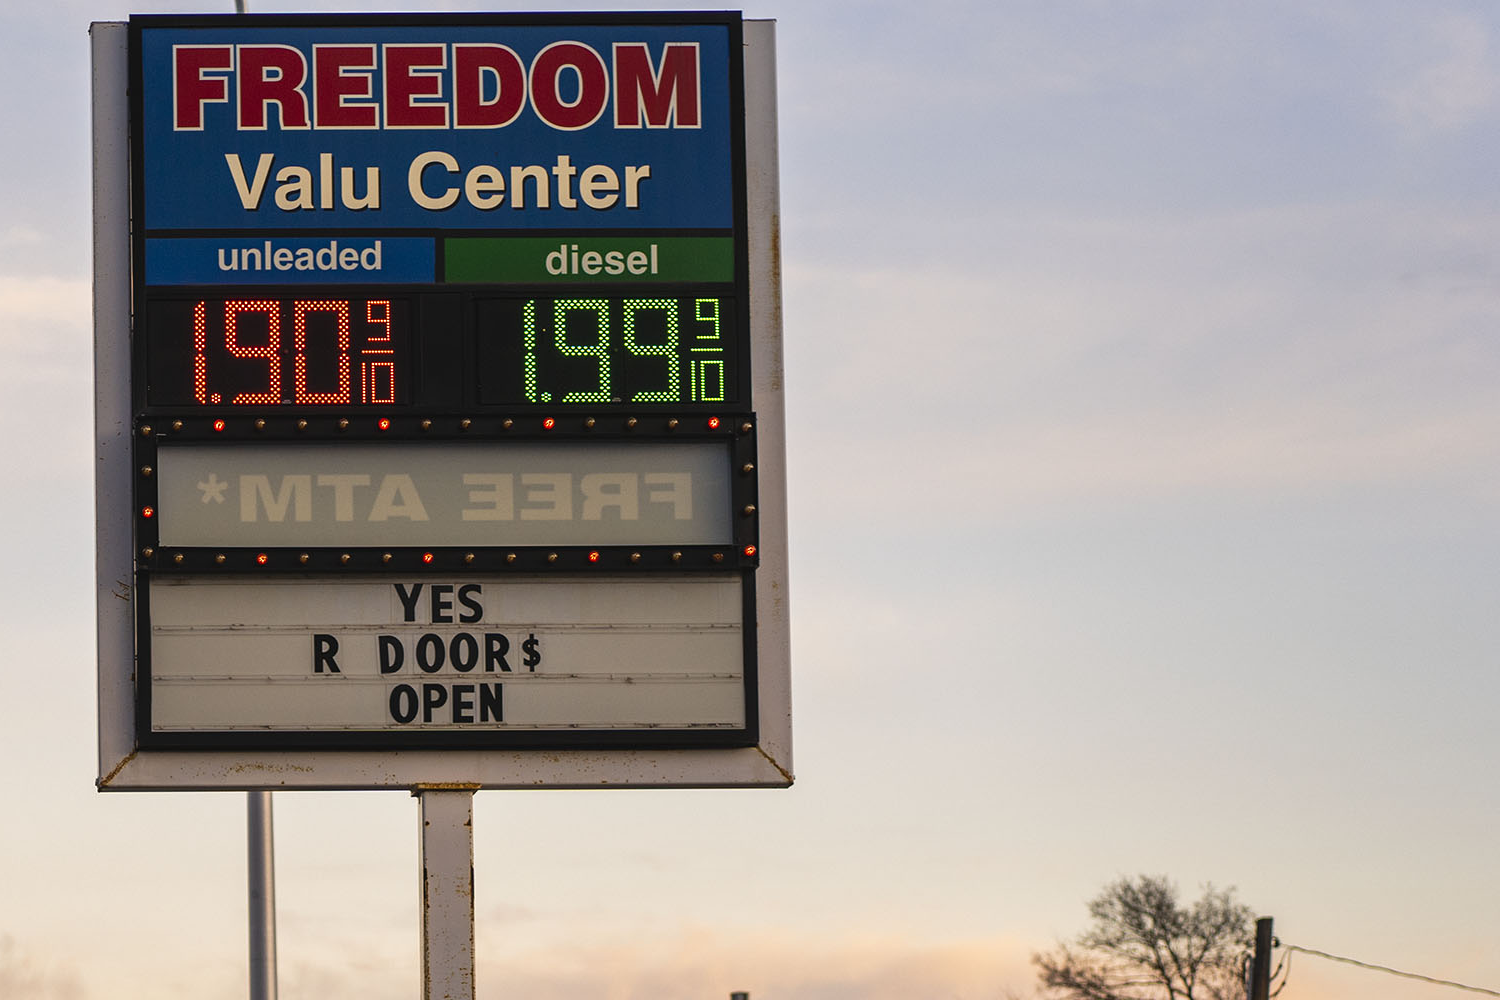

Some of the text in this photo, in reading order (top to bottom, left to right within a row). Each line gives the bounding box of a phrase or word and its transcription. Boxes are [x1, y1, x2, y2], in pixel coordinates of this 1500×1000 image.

[171, 40, 701, 131] FREEDOM
[224, 151, 651, 211] Valu Center
[217, 240, 383, 271] unleaded
[545, 243, 659, 275] diesel
[392, 583, 484, 625] YES
[313, 633, 341, 674] R
[388, 682, 504, 725] OPEN
